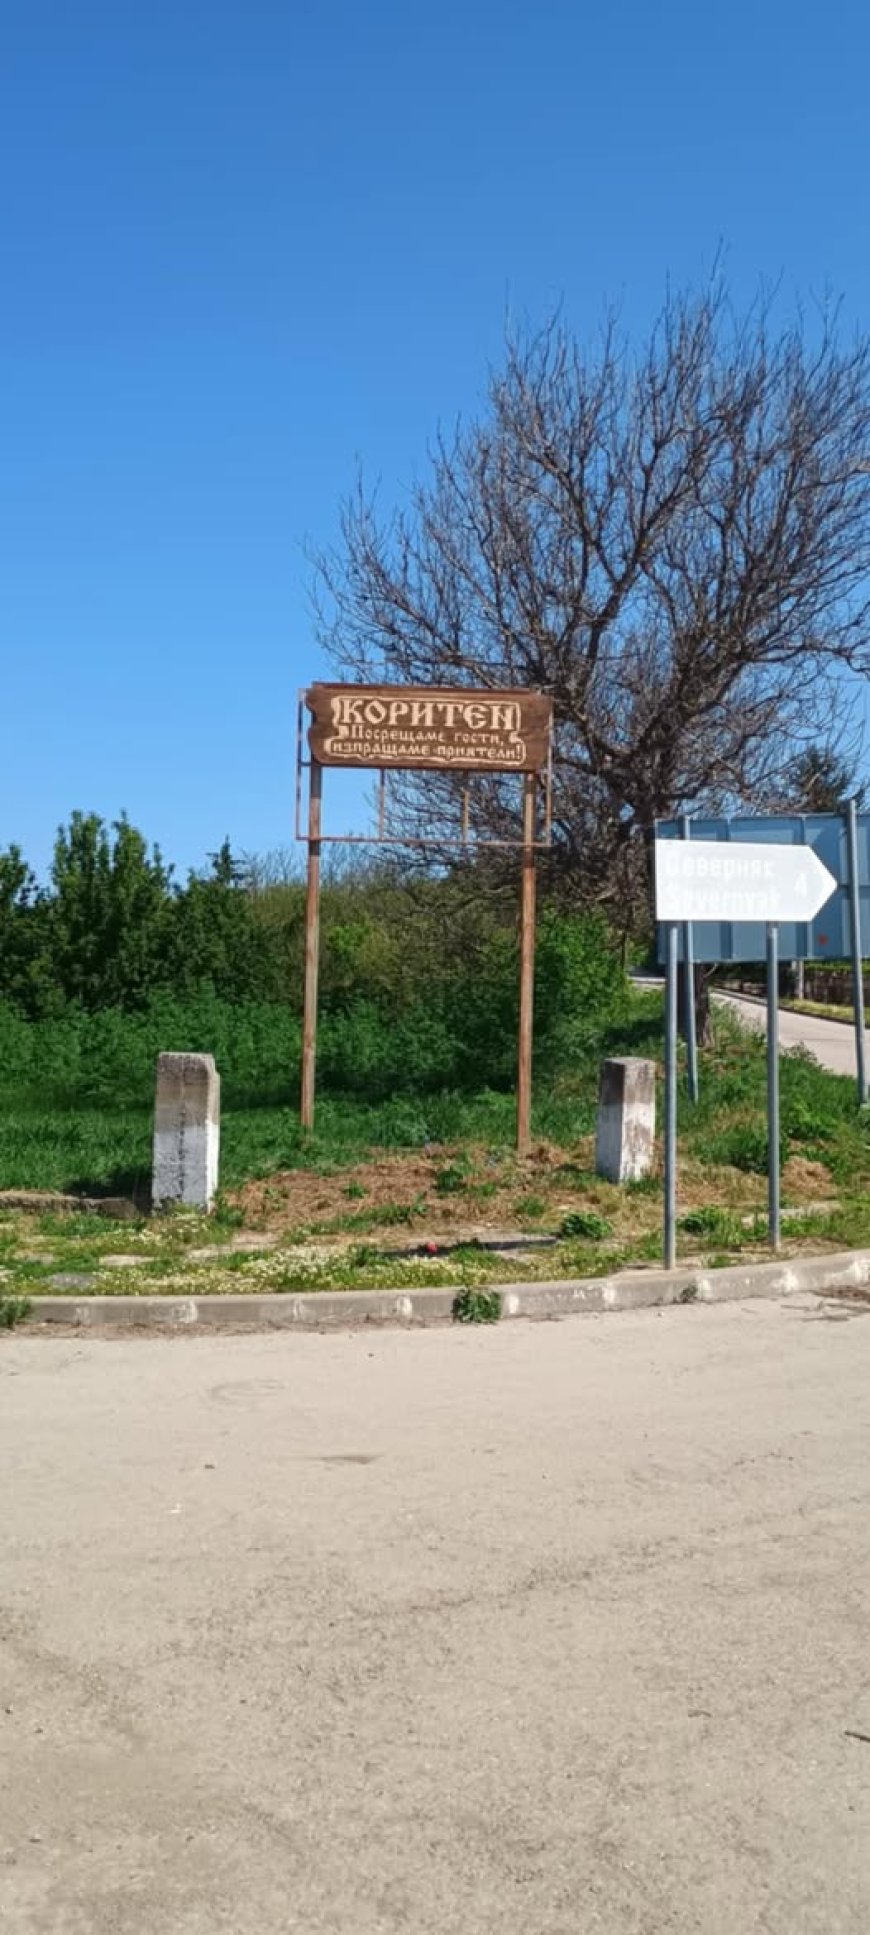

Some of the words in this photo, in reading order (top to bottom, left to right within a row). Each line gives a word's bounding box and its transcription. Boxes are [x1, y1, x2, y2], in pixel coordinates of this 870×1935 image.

[341, 699, 517, 730] КОРИТЕН
[351, 724, 446, 743] Посрещаме
[454, 731, 505, 745] гости,
[332, 741, 430, 757] изпращаме
[437, 743, 524, 760] приятели!
